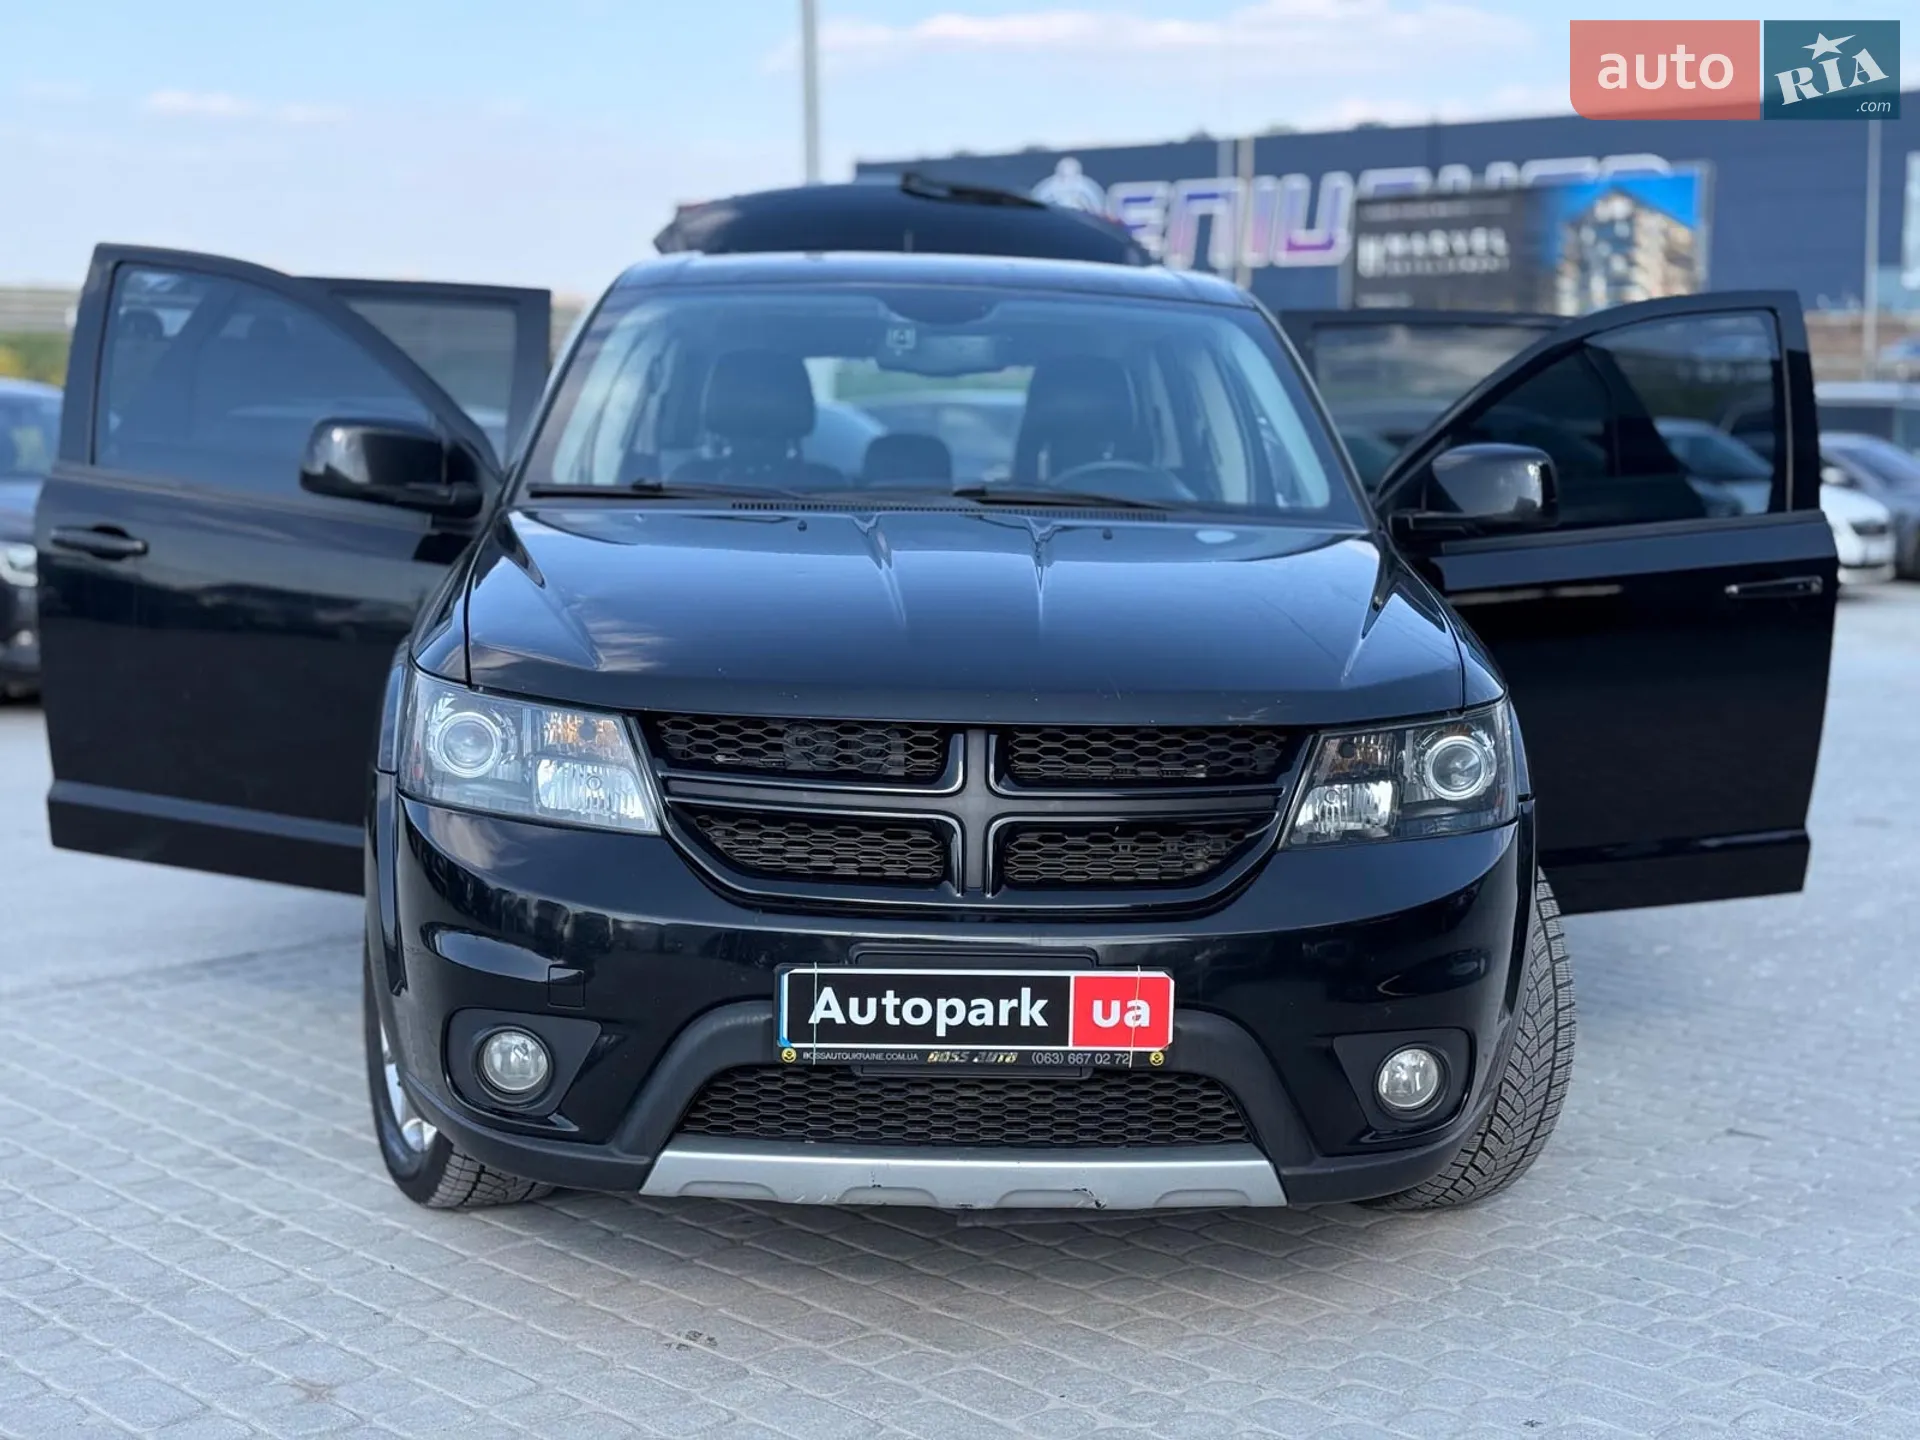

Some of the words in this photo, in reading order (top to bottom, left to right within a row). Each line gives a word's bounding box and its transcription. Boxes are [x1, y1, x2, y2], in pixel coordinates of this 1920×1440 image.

[808, 986, 1049, 1037] Autopark
[1091, 998, 1151, 1028] ua
[1031, 1052, 1065, 1065] (063)
[1067, 1052, 1091, 1065] 667
[1094, 1053, 1111, 1065] 02
[1114, 1053, 1130, 1065] 72
